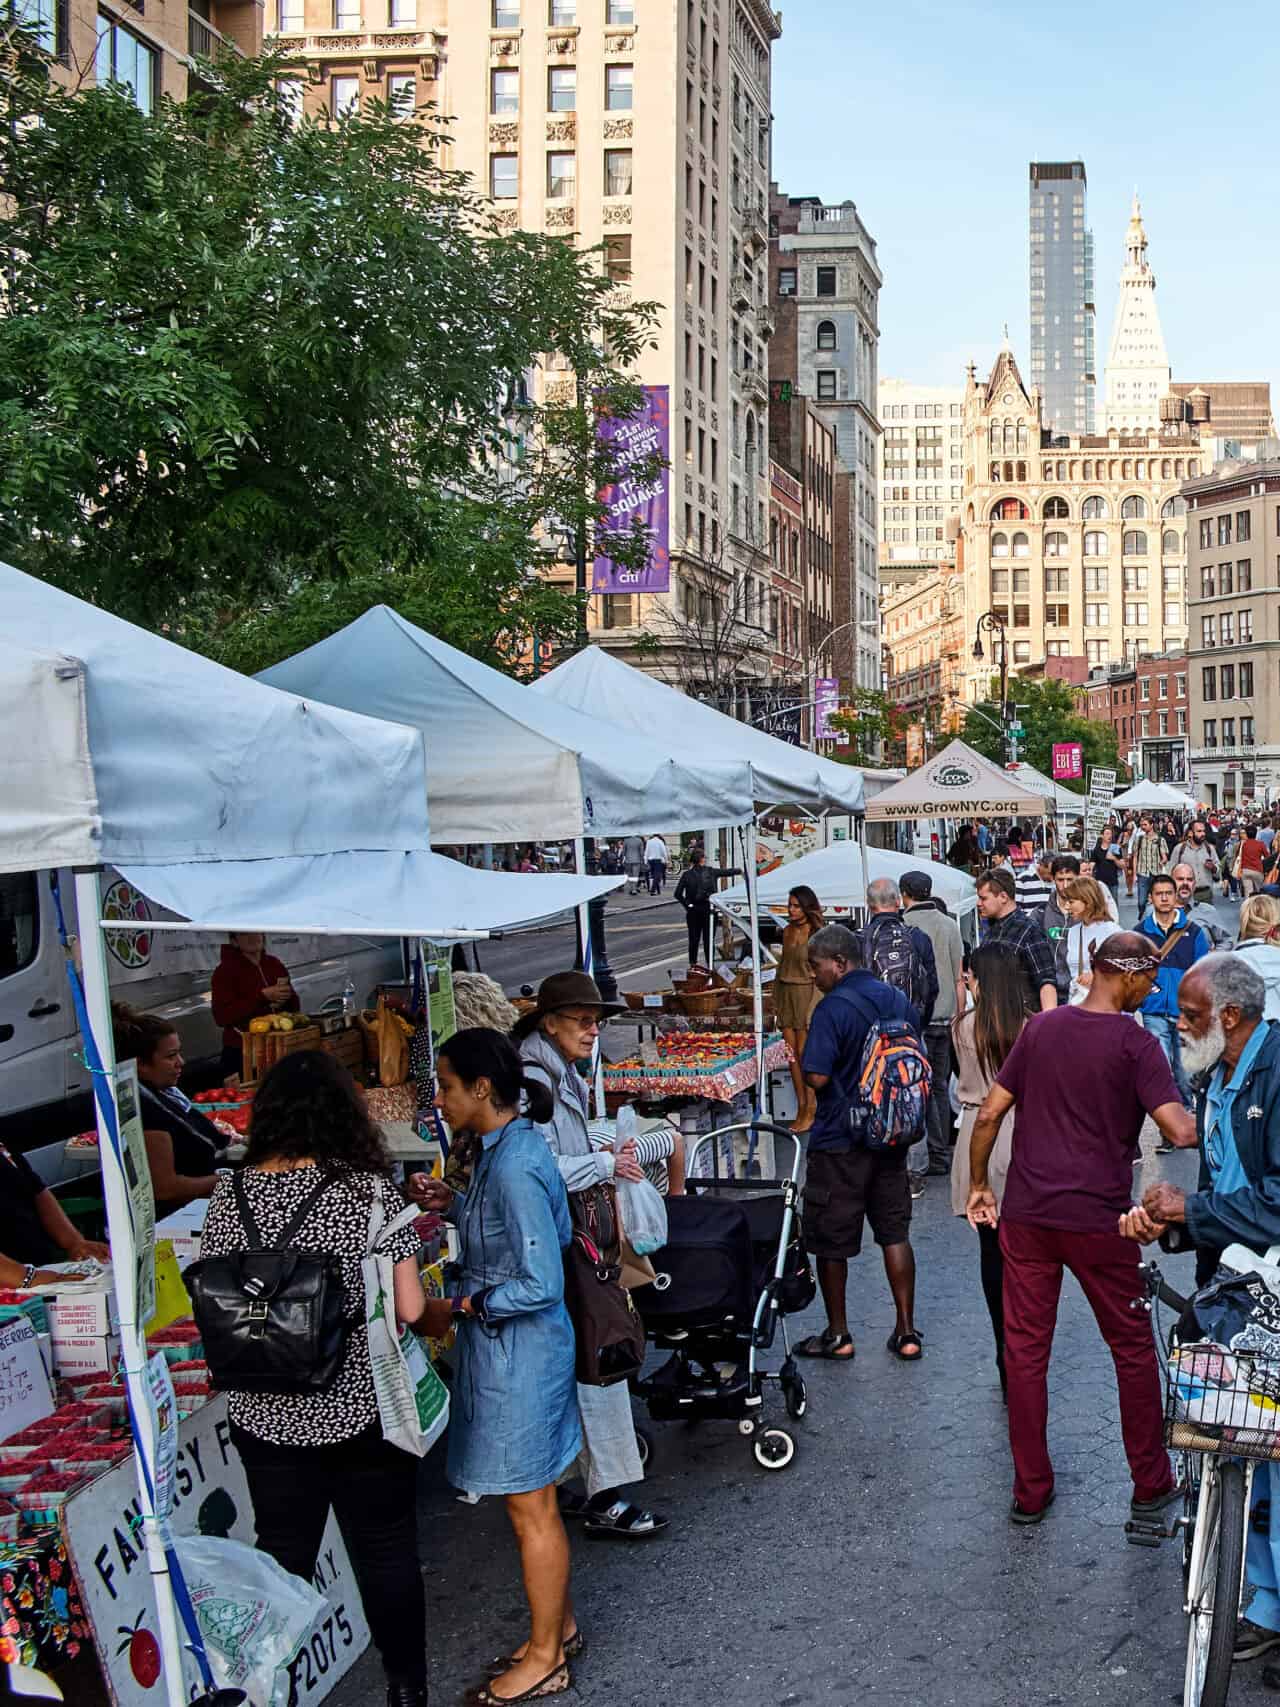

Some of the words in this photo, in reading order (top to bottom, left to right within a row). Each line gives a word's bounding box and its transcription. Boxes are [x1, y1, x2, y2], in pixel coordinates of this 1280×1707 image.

[1056, 754, 1070, 769] EBT
[885, 800, 1018, 815] www.GrowNYC.org
[297, 1603, 353, 1692] 2075
